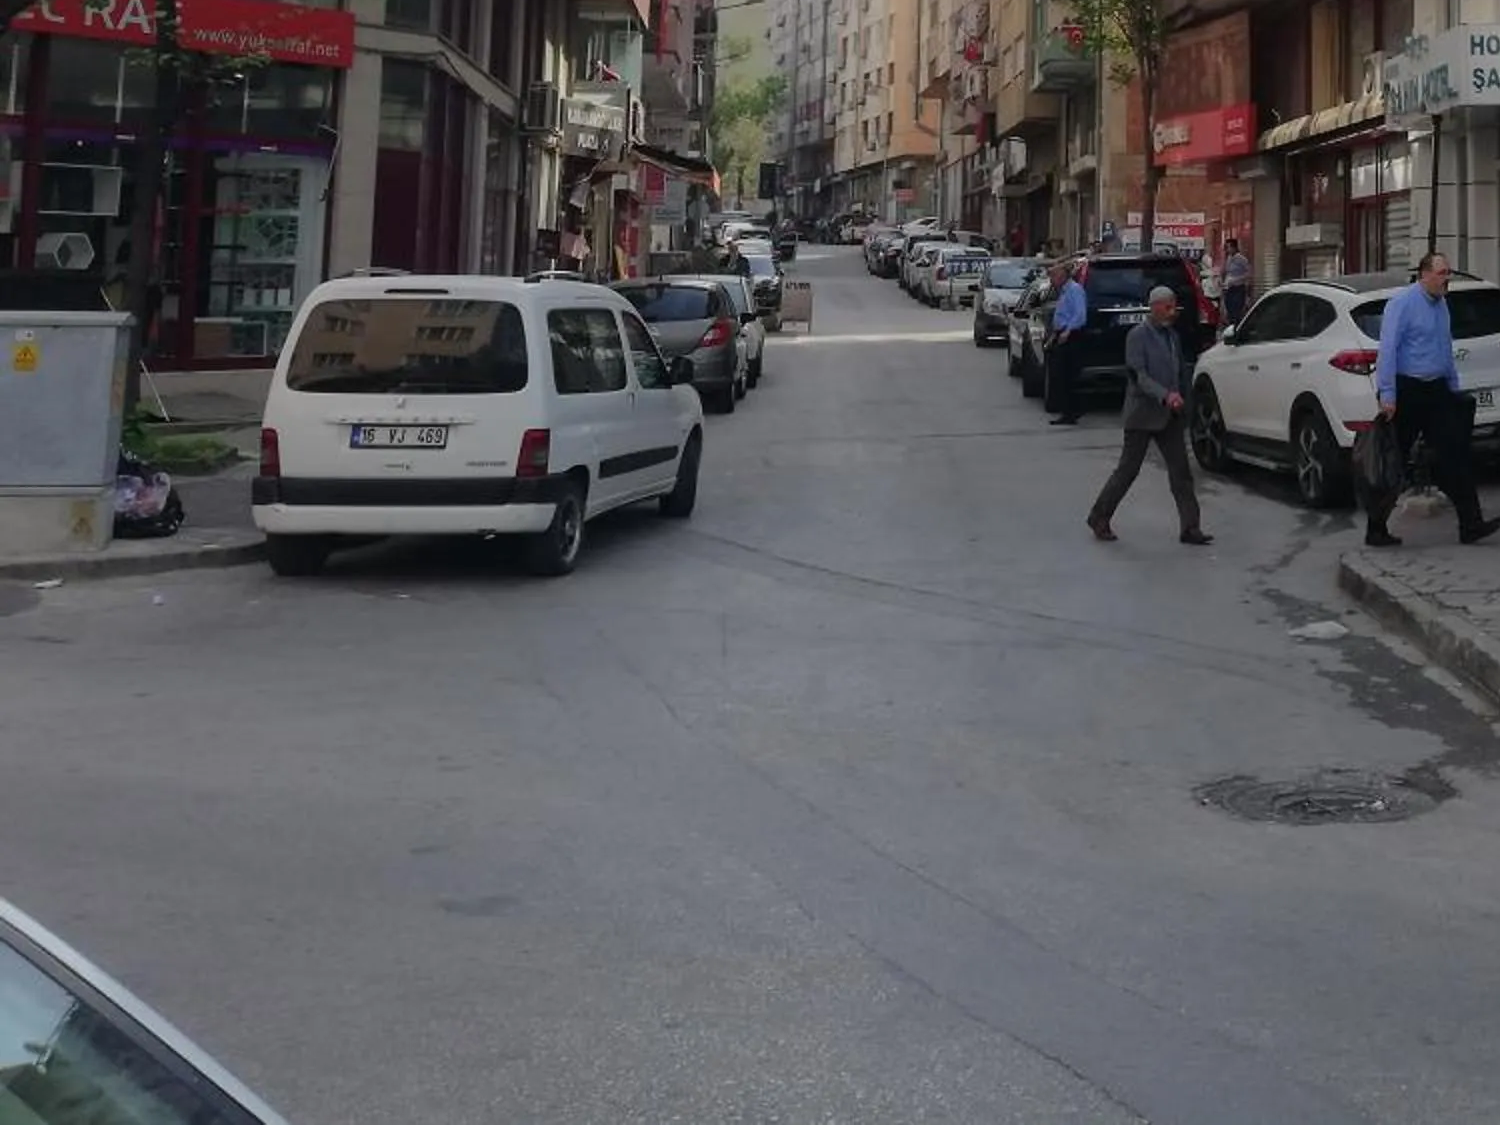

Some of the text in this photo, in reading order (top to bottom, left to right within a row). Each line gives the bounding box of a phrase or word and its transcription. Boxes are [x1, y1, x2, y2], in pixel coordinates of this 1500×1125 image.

[362, 428, 443, 444] 16 VJ 469
